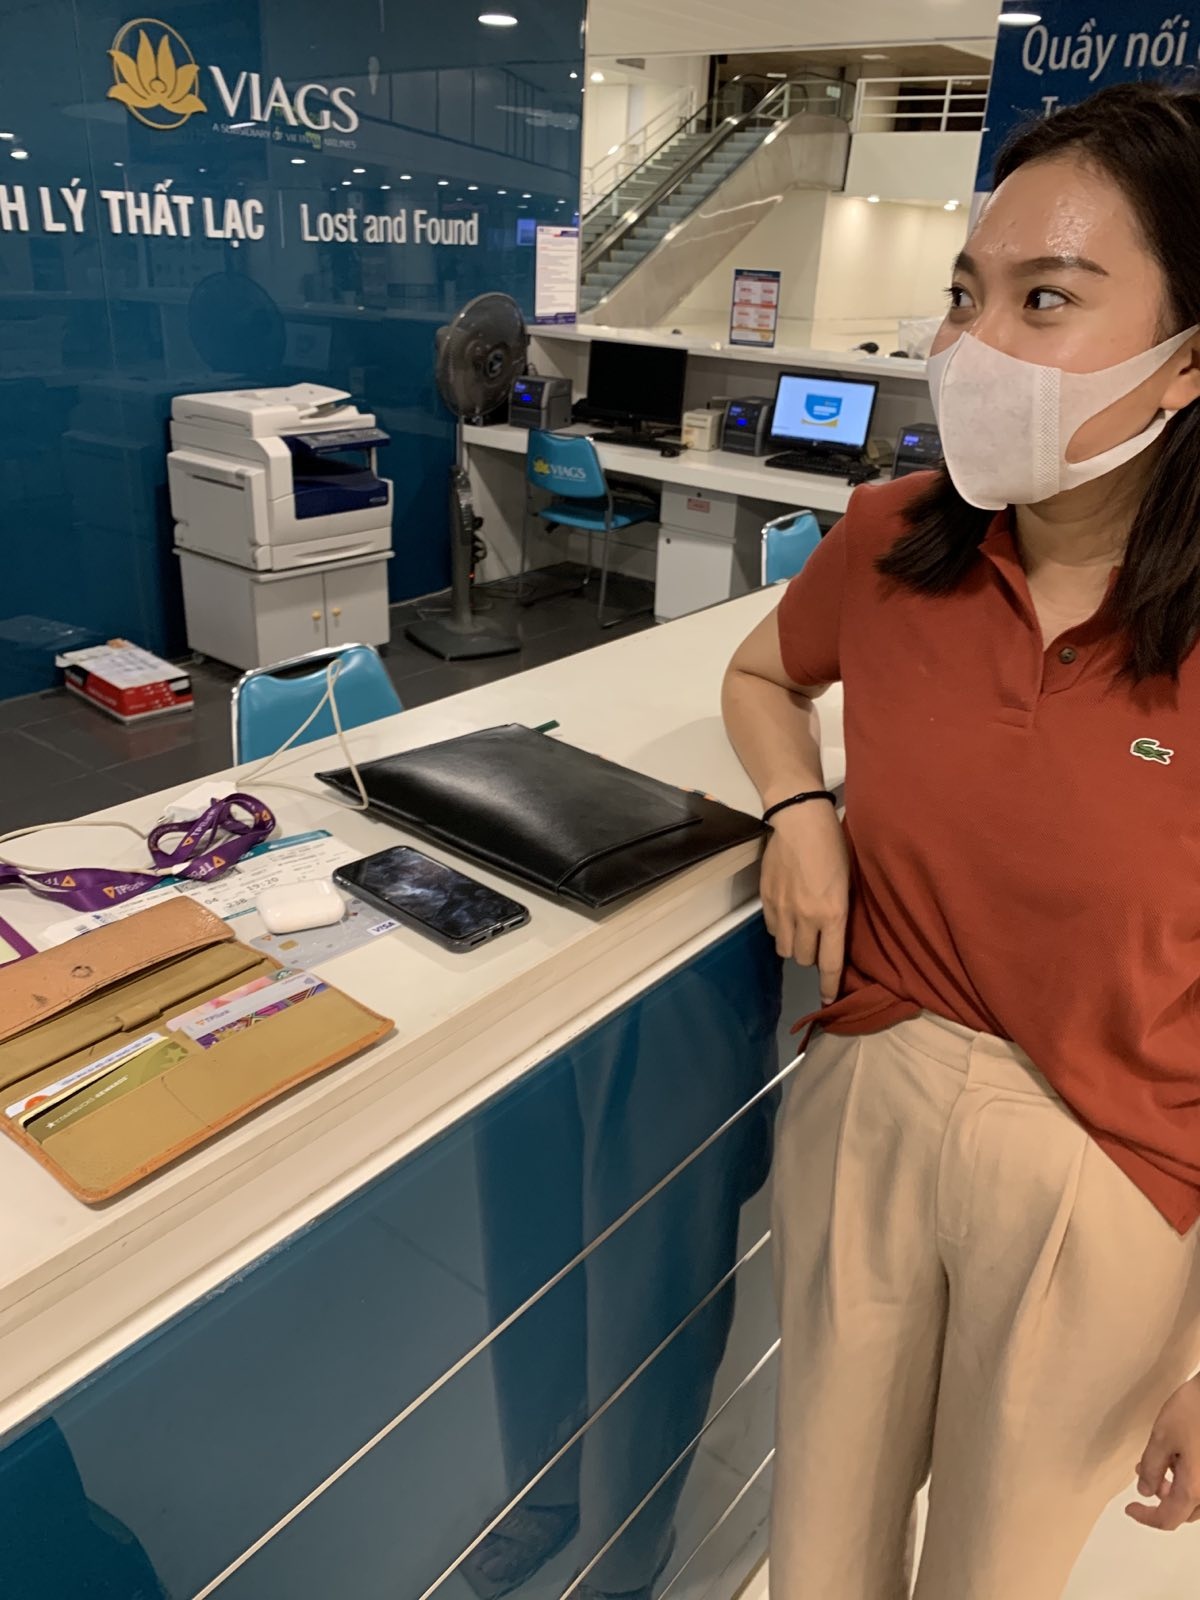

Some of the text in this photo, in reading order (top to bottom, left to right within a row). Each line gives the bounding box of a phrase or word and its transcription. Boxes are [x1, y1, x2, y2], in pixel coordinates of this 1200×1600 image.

[1022, 14, 1190, 82] Quầy nối
[208, 65, 359, 133] VIAGS
[39, 177, 87, 232] LÝ
[100, 179, 194, 237] THẤT
[202, 196, 265, 248] LẠC
[300, 203, 479, 246] Lost and Found
[373, 921, 396, 933] VISA
